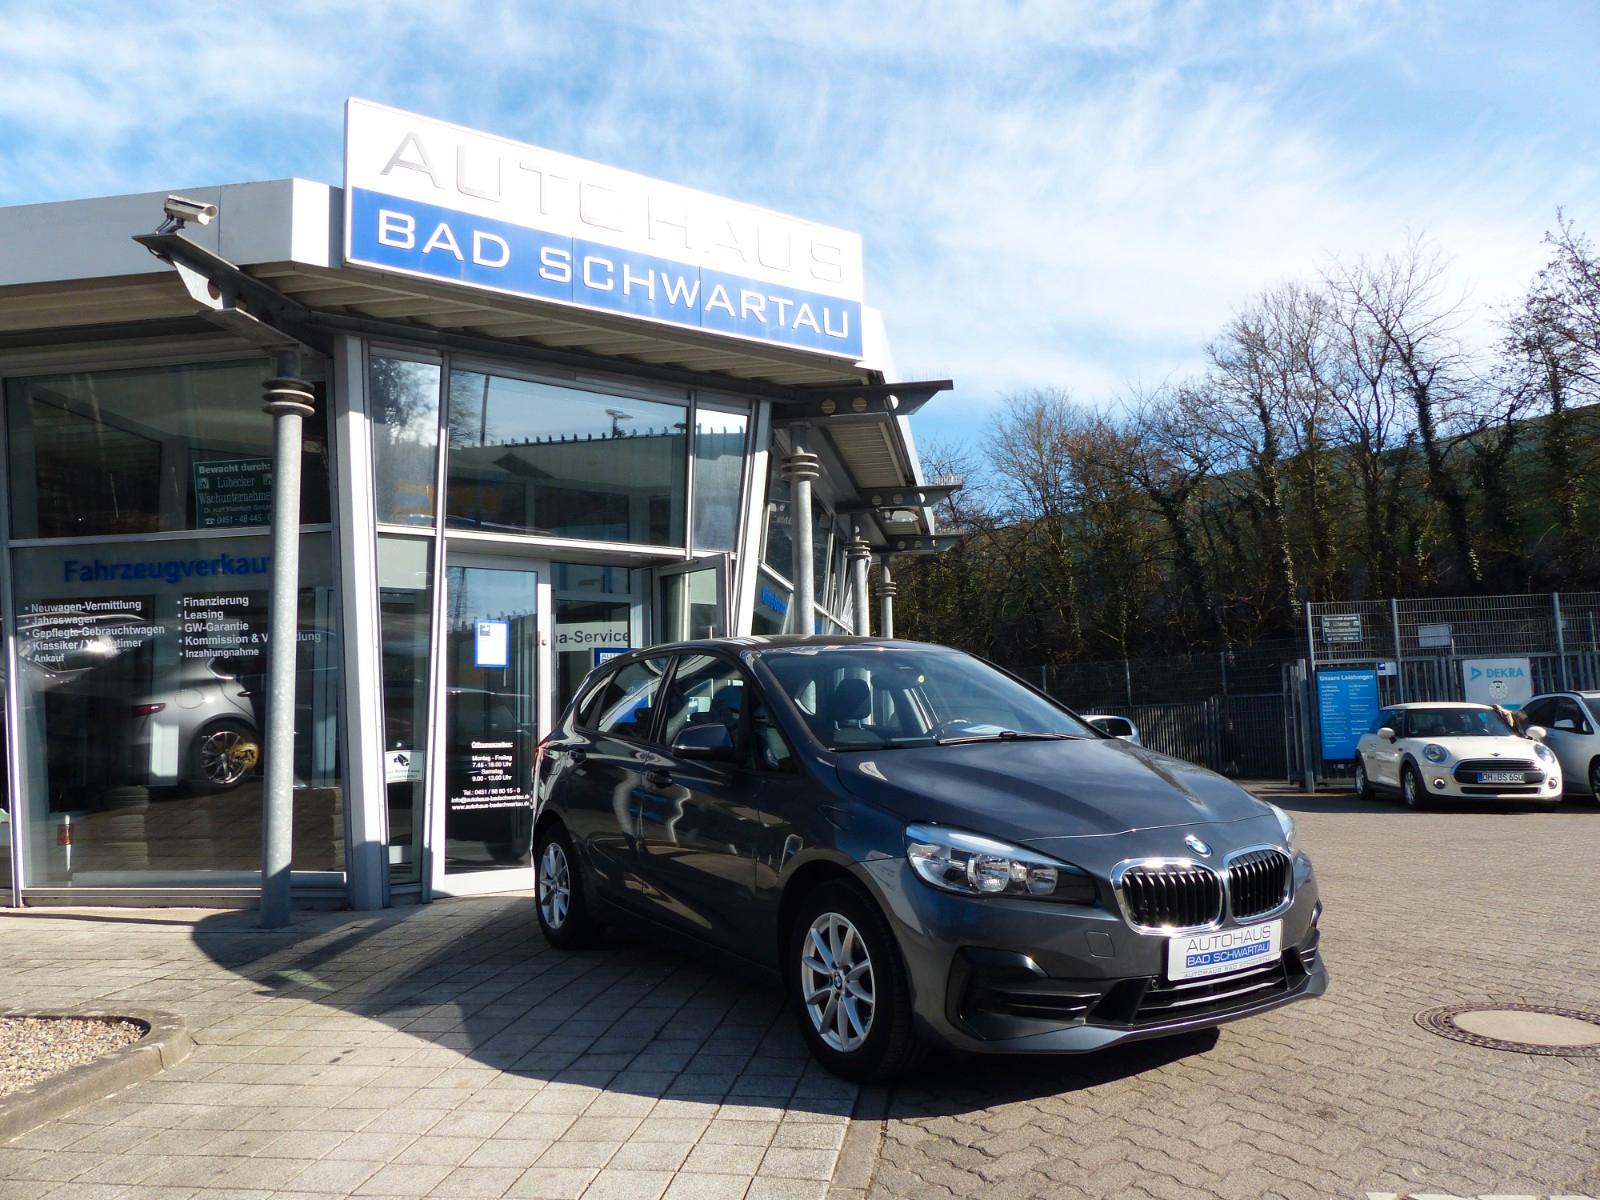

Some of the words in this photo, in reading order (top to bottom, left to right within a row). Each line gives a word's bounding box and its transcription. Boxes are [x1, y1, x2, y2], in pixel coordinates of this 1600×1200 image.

[380, 131, 843, 284] AUTOHAUS
[378, 209, 511, 269] BAD
[539, 246, 850, 340] SCHWARTAU
[63, 553, 271, 584] Fahrzeugverkau
[31, 600, 142, 614] Neuwagen-Vermittlung
[183, 595, 249, 607] Finanzierung
[32, 616, 97, 627] Jahreswagen
[184, 610, 224, 621] Leasing
[32, 628, 81, 640] Gepflegte
[81, 625, 165, 637] Gebrauchtwagen
[184, 621, 249, 633] GW-Garantie
[185, 633, 248, 646] Kommission
[251, 633, 259, 643] &
[556, 629, 629, 644] a-Service
[33, 640, 79, 651] Klassiker
[34, 653, 65, 663] Ankauf
[185, 649, 260, 659] Inzahlungnahme
[1486, 668, 1524, 679] DEKRA
[1186, 925, 1271, 953] AUTOHAUS
[1187, 954, 1211, 967] BAD
[1213, 942, 1270, 962] SCHWARTAU
